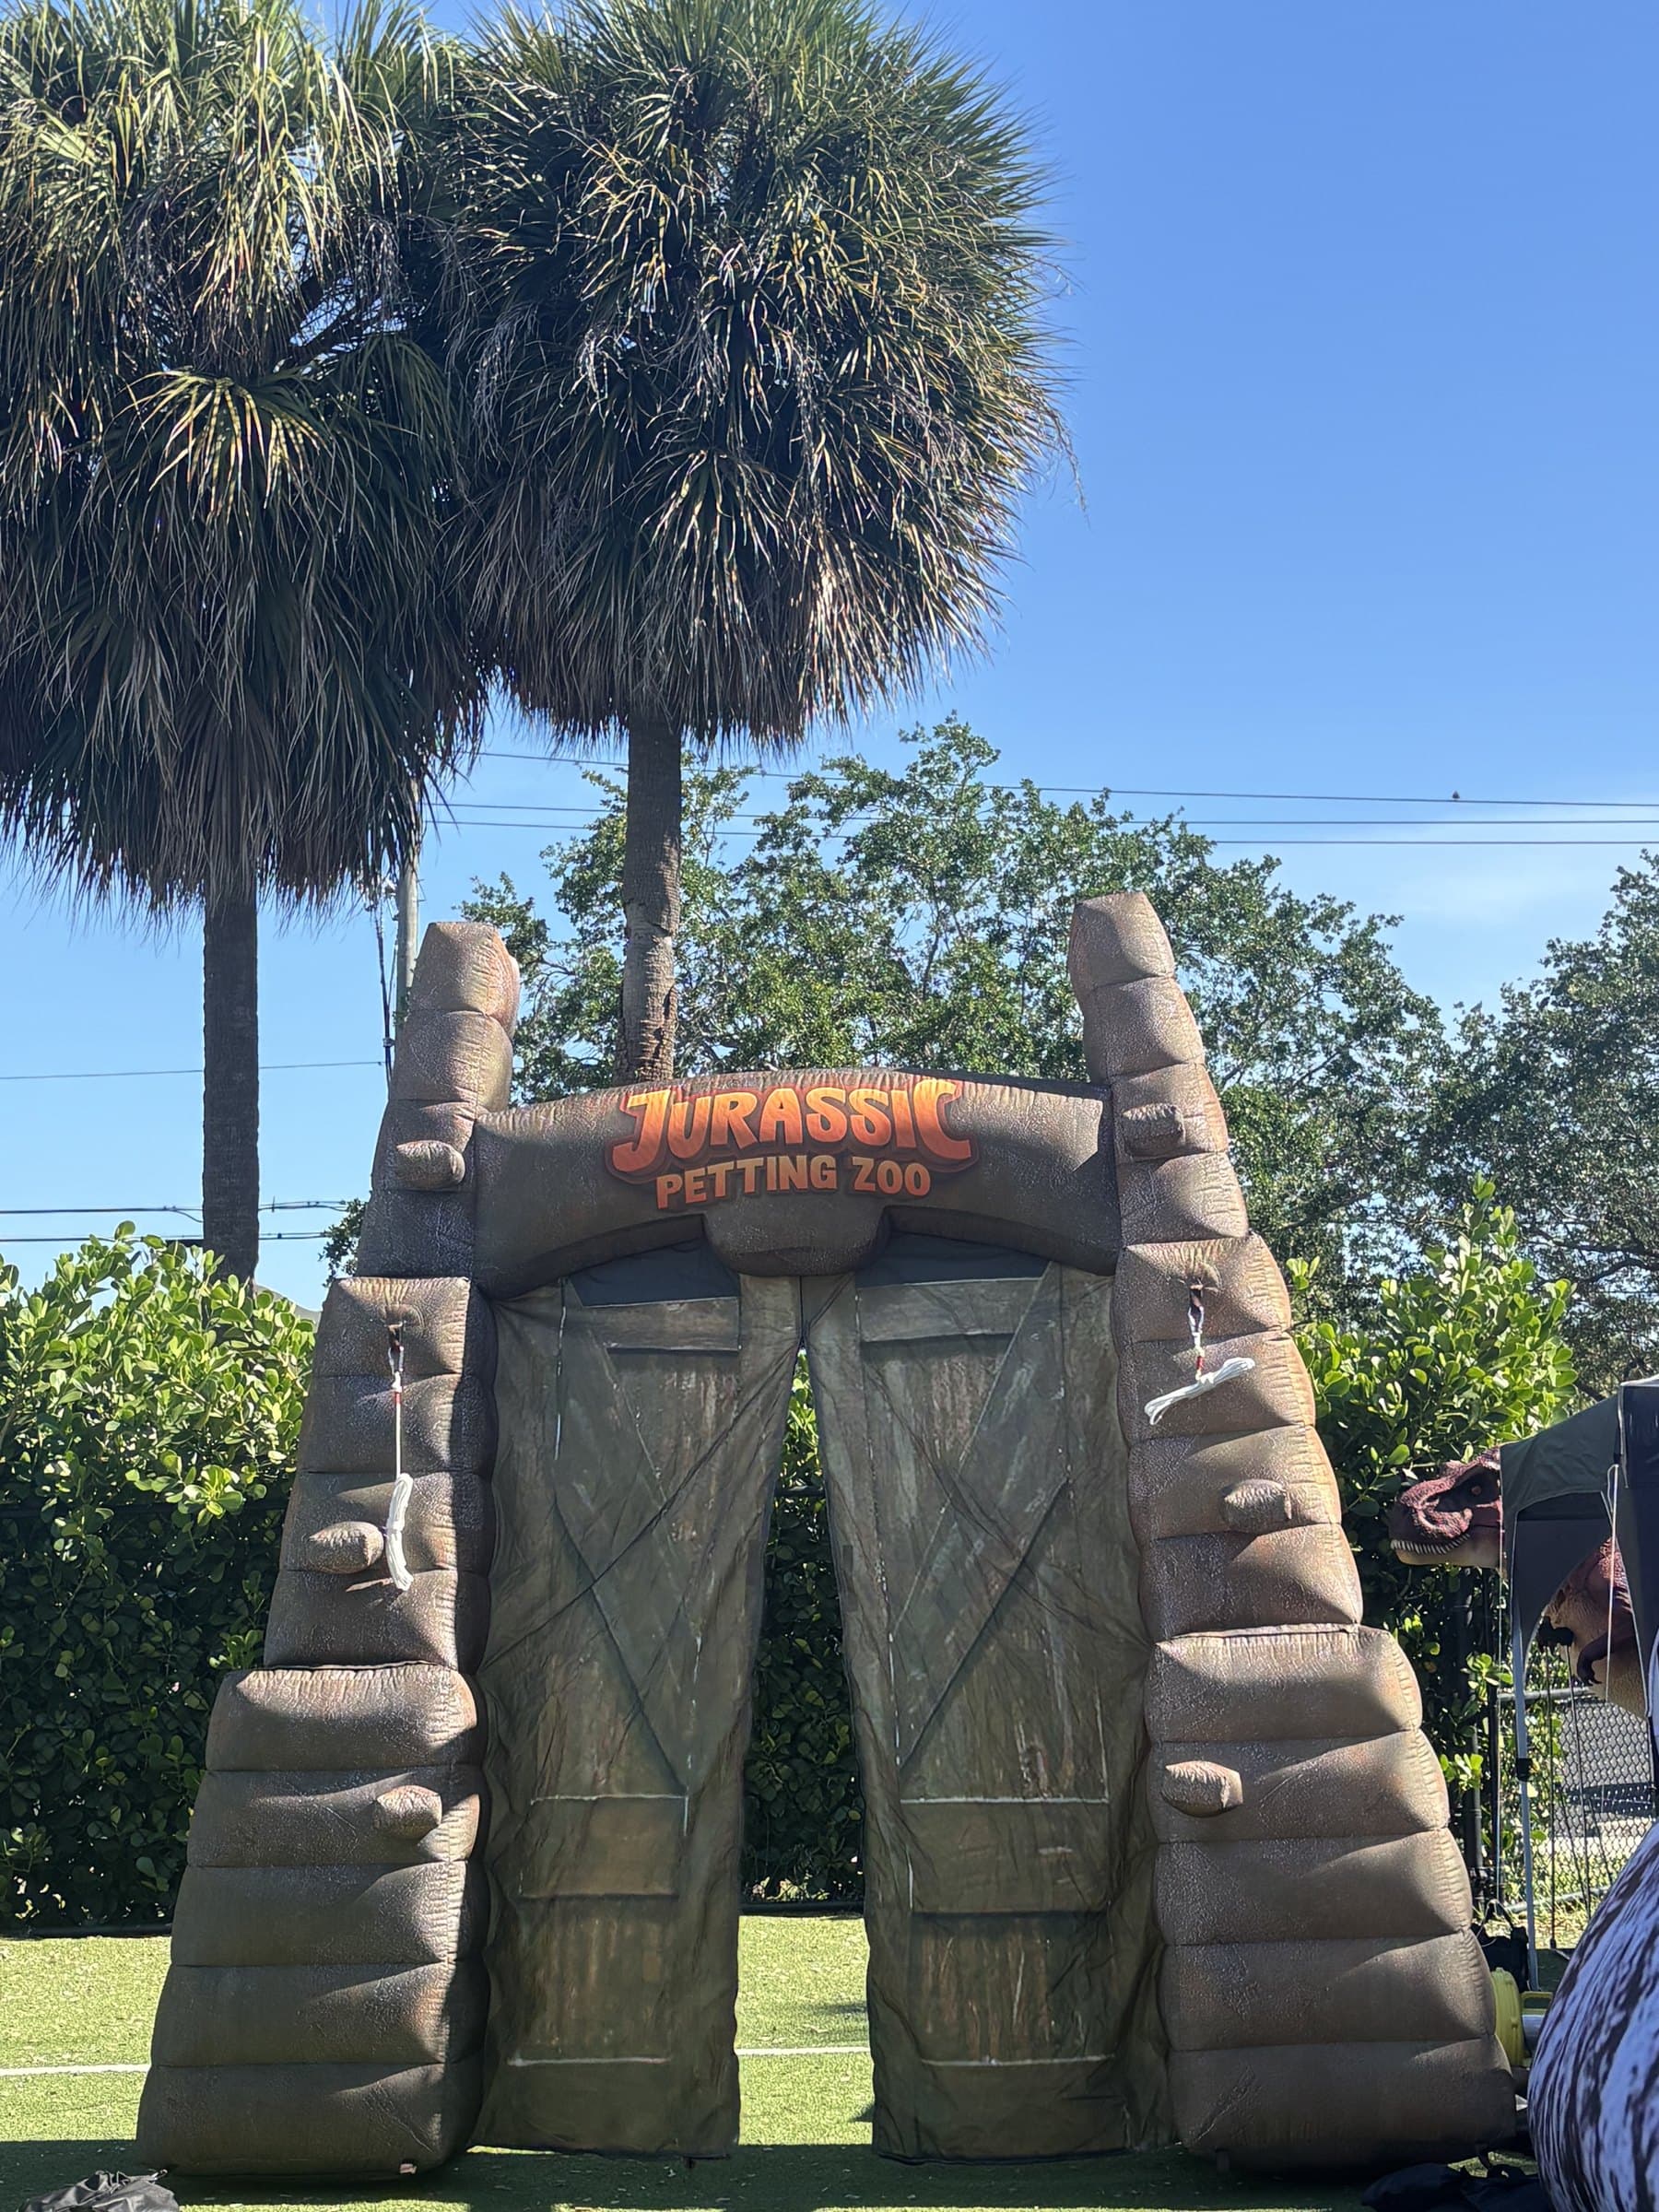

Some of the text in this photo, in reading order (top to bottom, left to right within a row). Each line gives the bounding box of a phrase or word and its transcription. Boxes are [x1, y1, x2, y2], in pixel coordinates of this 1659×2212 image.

[612, 1077, 971, 1172] JURASSIC
[655, 1155, 931, 1209] PETTING ZOO
